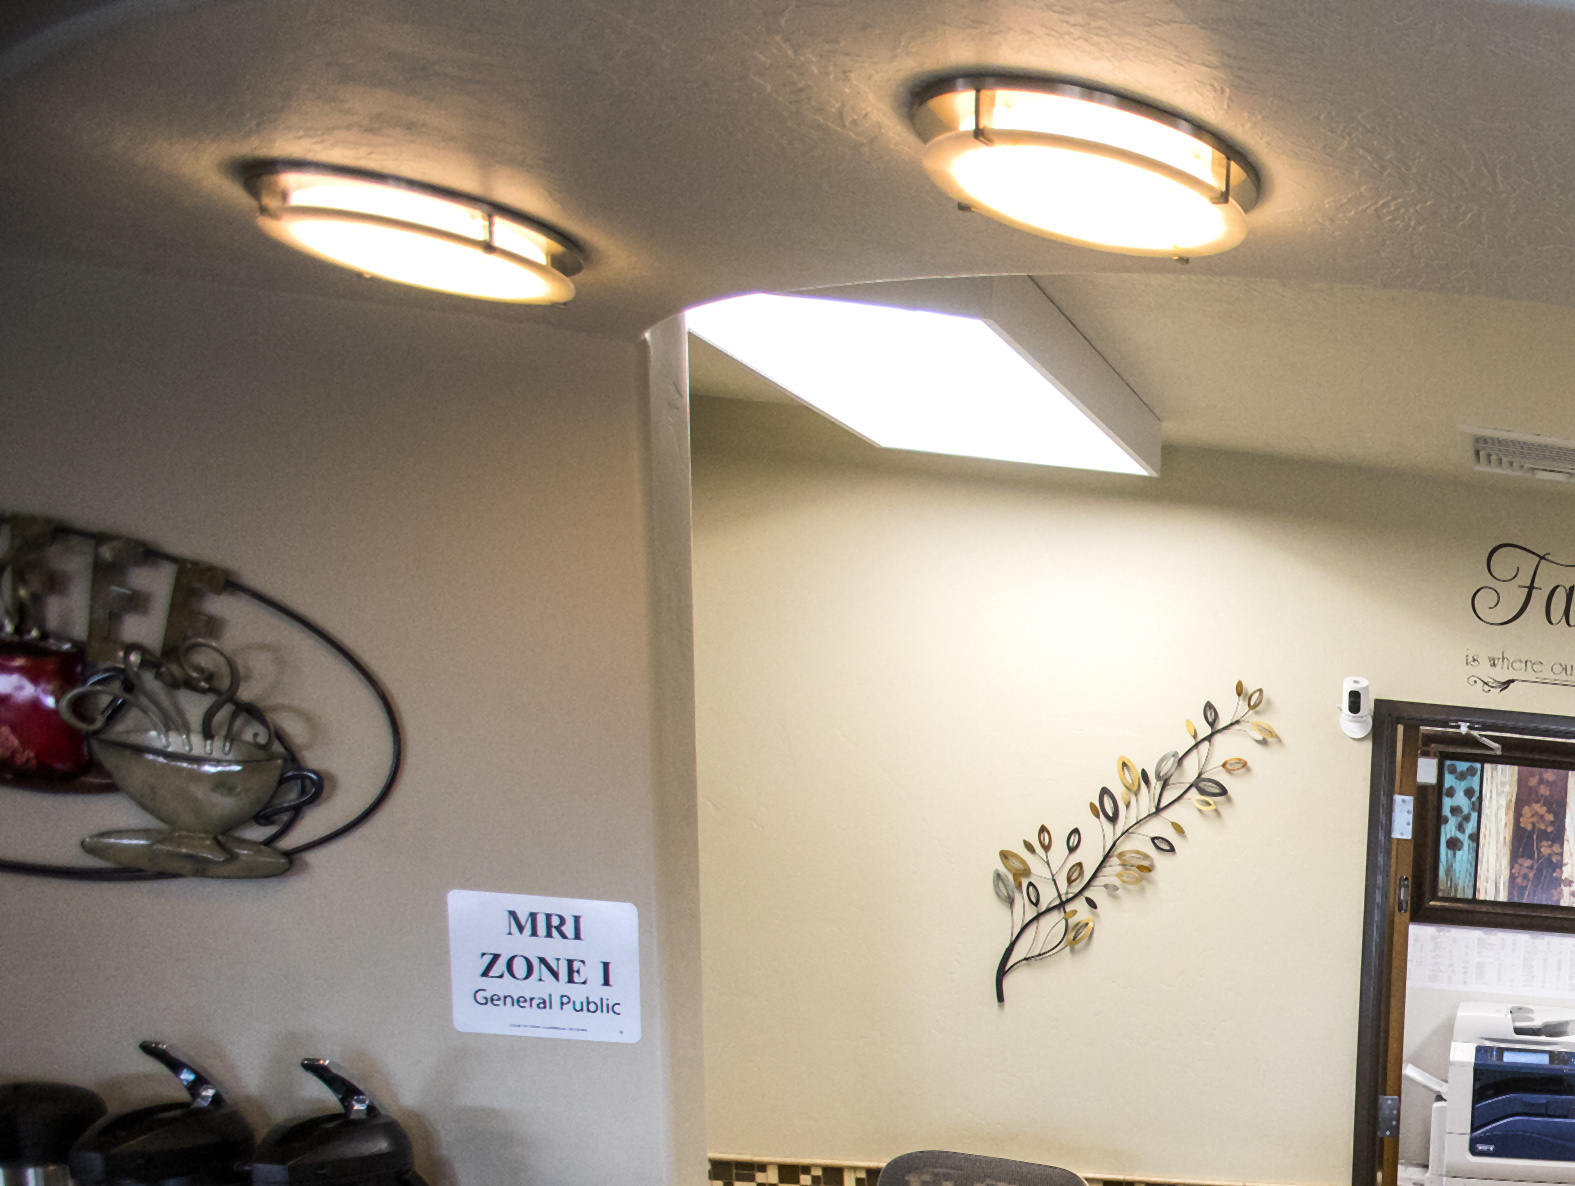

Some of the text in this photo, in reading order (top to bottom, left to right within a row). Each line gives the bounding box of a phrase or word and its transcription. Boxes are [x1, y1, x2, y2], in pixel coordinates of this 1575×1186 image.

[1465, 648, 1481, 667] is
[1487, 651, 1544, 674] where
[505, 909, 584, 941] MRI
[479, 952, 613, 987] ZONE I
[473, 988, 621, 1015] General Public
